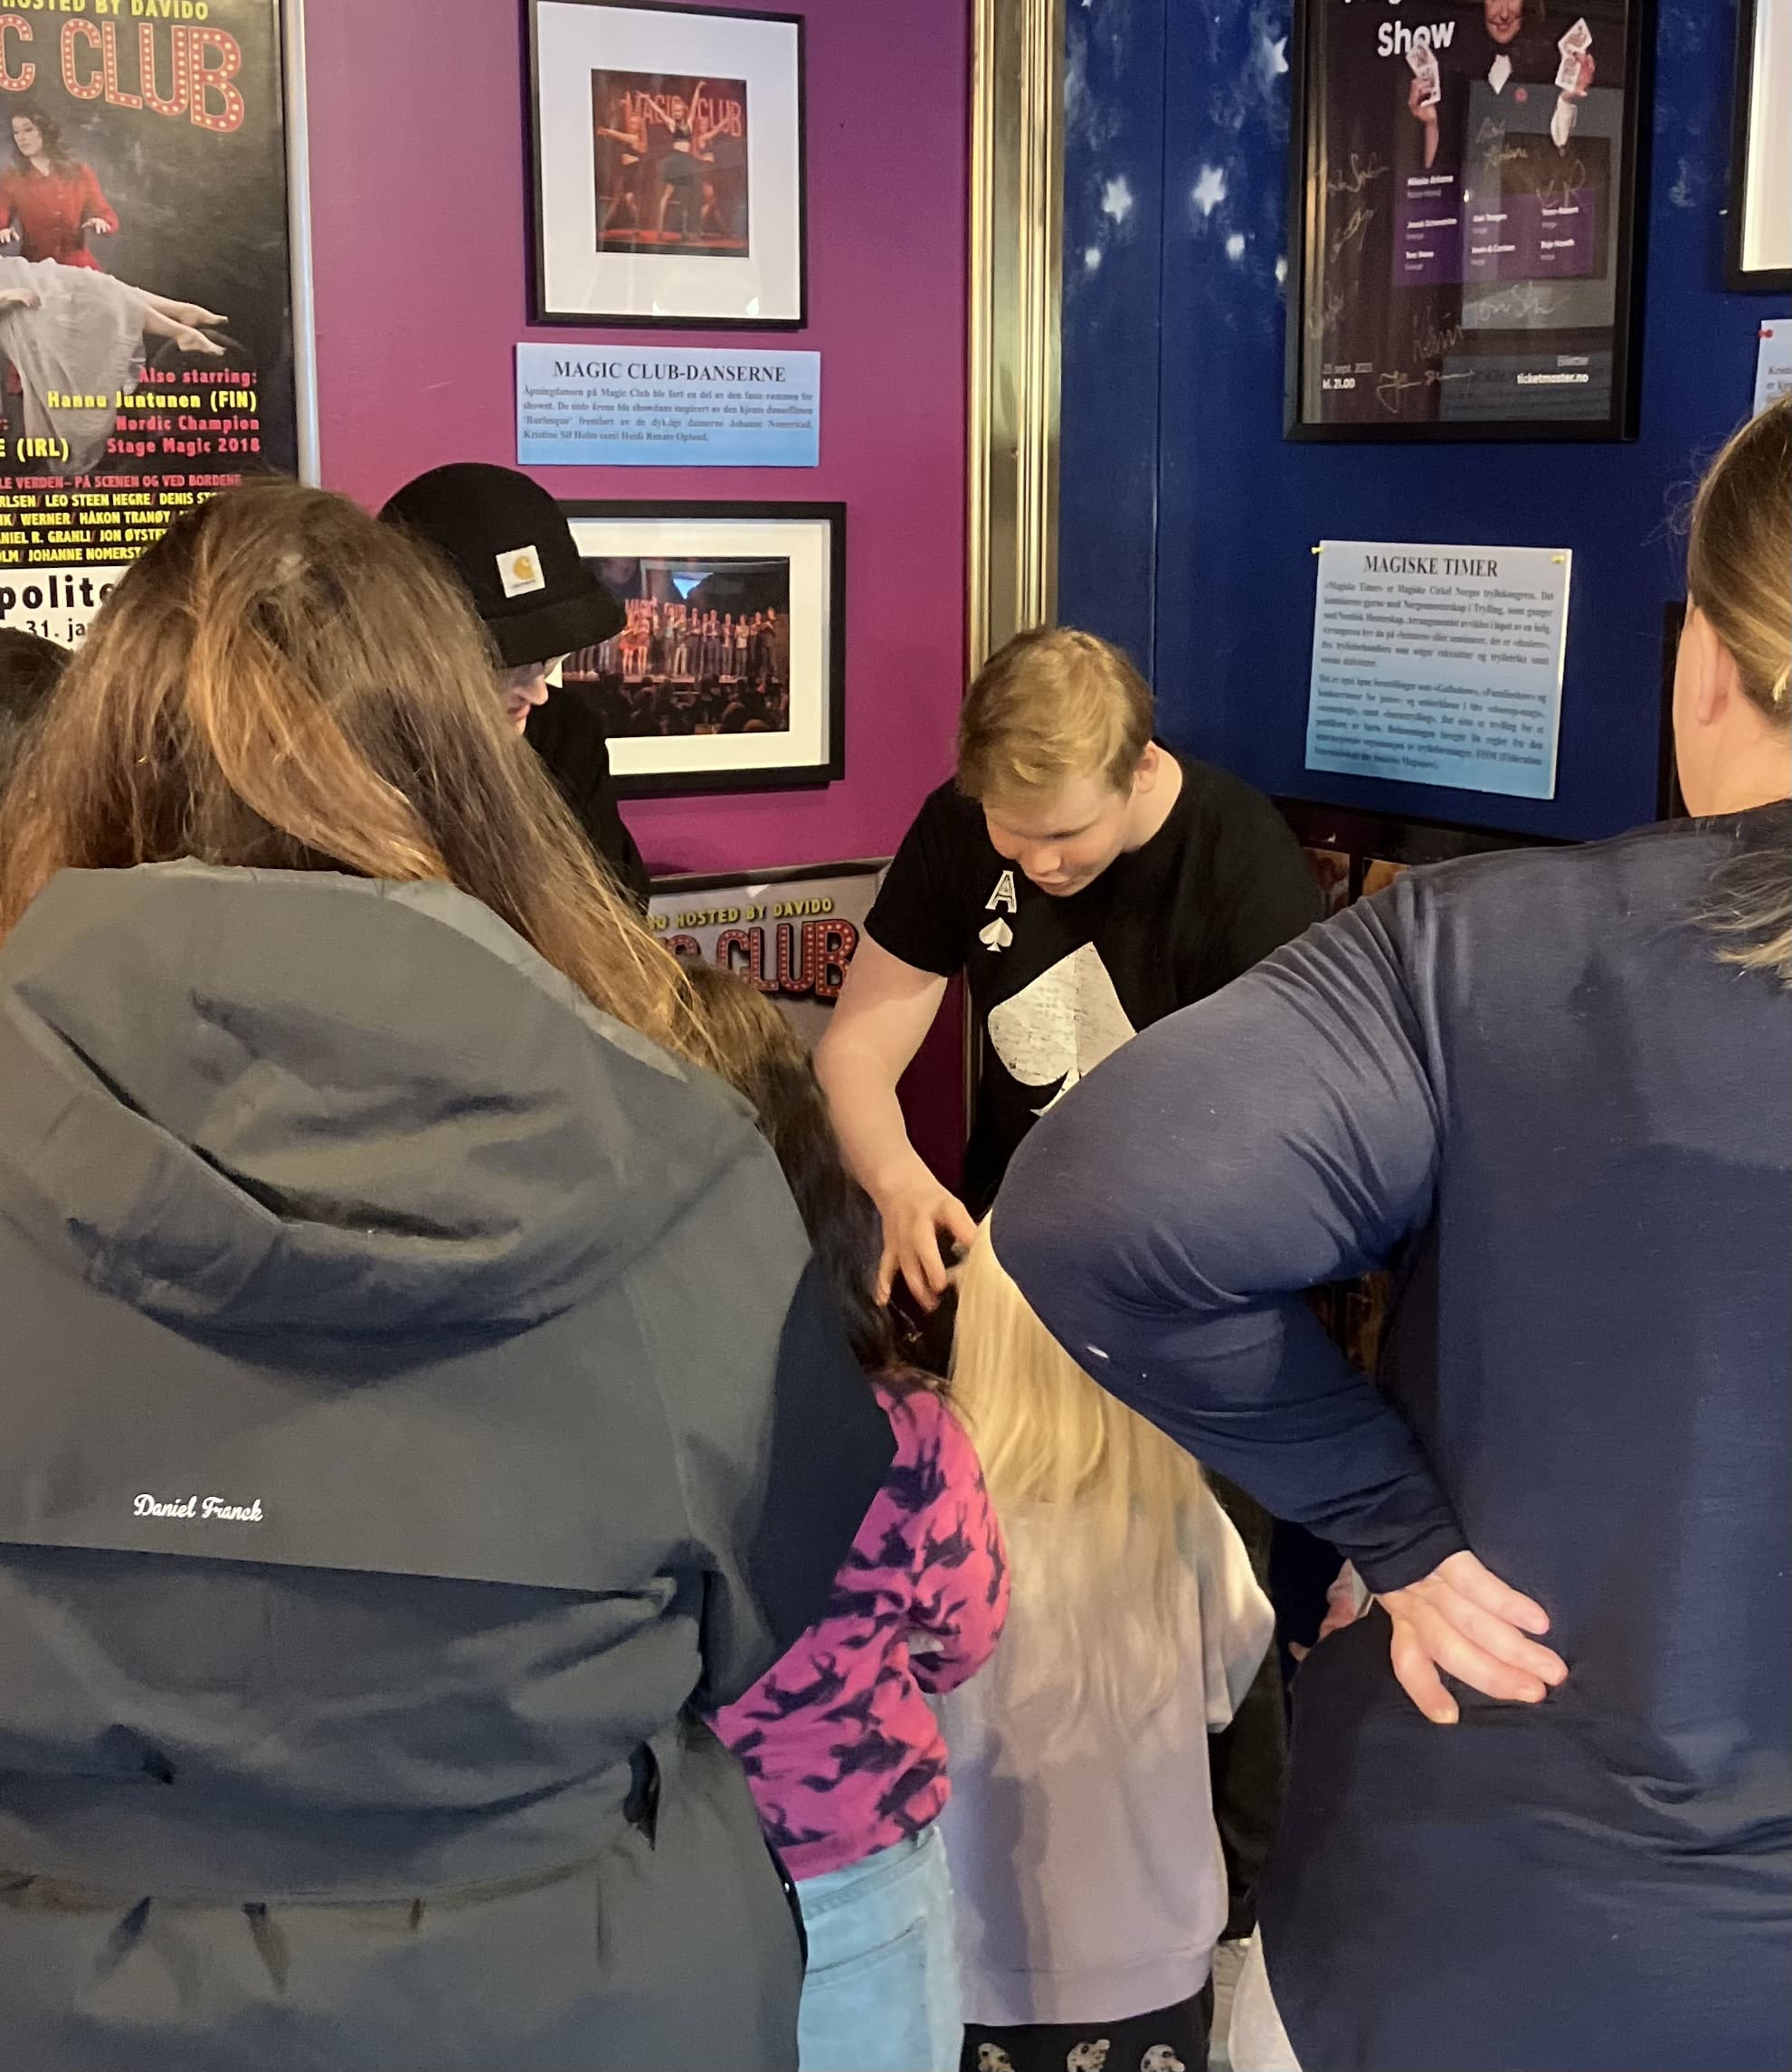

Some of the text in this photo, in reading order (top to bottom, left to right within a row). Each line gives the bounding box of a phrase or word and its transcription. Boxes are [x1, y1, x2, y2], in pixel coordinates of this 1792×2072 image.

[95, 0, 119, 14] BY
[131, 0, 209, 20] DAVIDO
[1378, 21, 1455, 57] Show
[61, 18, 245, 133] CLUB
[138, 367, 257, 388] Also starring:
[553, 361, 786, 383] MAGIC CLUB-DANSERNE
[48, 390, 257, 412] Hannu Juntunen (FIN)
[116, 414, 260, 434] Nordic Champion
[17, 438, 69, 462] (IRL)
[107, 437, 261, 457] Stage Magic 2018
[74, 474, 90, 488] PÅ
[142, 475, 159, 488] OG
[162, 474, 185, 487] VED
[44, 494, 69, 507] LEO
[71, 493, 109, 506] STEEN
[159, 492, 194, 506] DENIS
[80, 509, 120, 525] HÅKON
[31, 531, 43, 544] R.
[100, 529, 121, 543] JON
[28, 548, 83, 563] JOHANNE
[86, 546, 147, 561] NOMERST
[1363, 554, 1498, 578] MAGISKE TIMER
[985, 870, 1017, 913] A
[674, 907, 740, 928] HOSTED
[746, 904, 767, 921] BY
[773, 897, 834, 917] DAVIDO
[716, 918, 859, 997] CLUB
[133, 1493, 263, 1522] Daniel Franck
